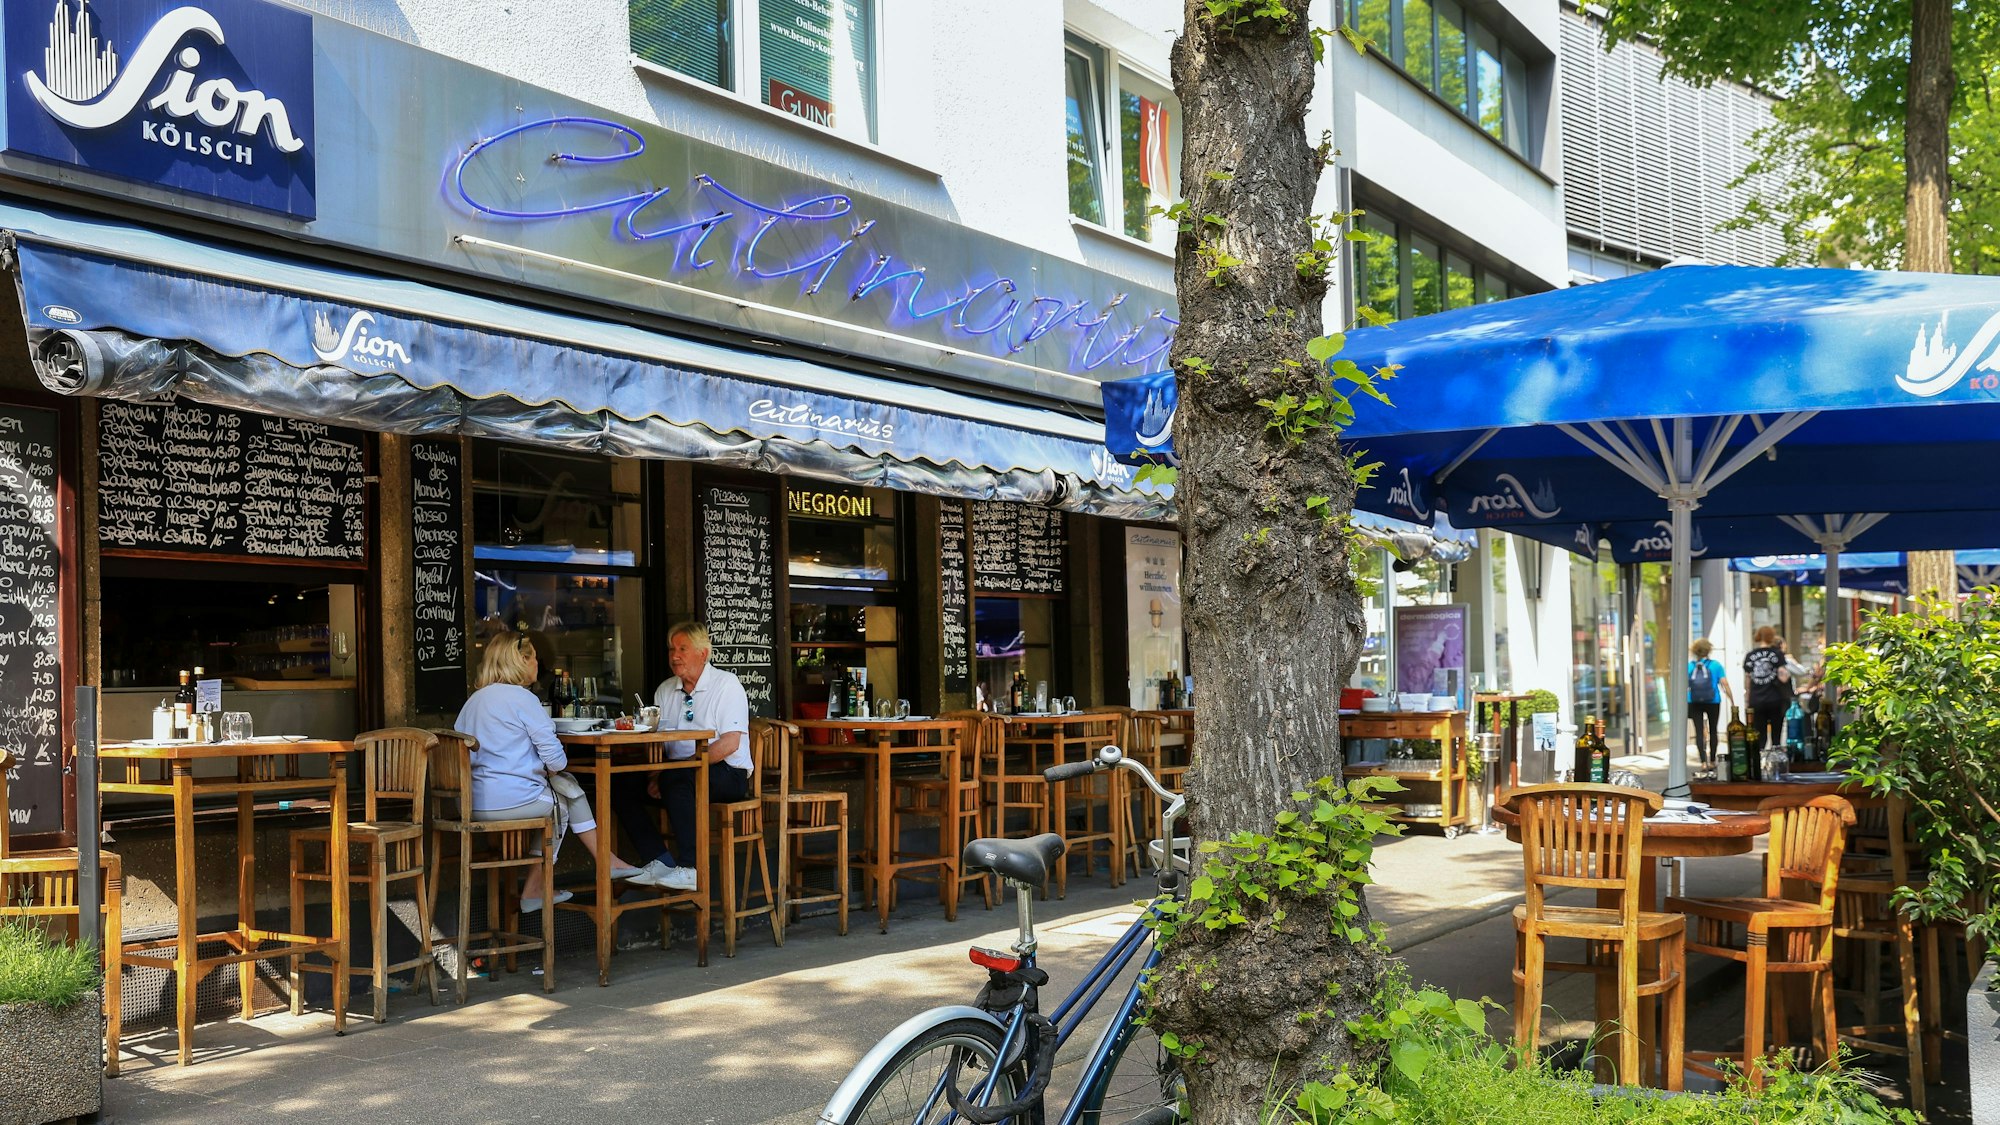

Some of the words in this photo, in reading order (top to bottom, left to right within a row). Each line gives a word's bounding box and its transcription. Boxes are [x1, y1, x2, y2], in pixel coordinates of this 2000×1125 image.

[24, 6, 304, 153] Sion
[142, 120, 252, 166] KÖLSCH
[311, 310, 411, 364] Sion
[352, 354, 395, 369] KÖLSCH
[749, 400, 893, 438] Culinarius
[412, 443, 457, 467] Rotwein
[429, 466, 449, 482] des
[414, 478, 451, 500] Monats
[412, 506, 448, 524] Rosso
[788, 490, 871, 517] NEGRONI
[414, 525, 458, 545] Veronese
[1400, 613, 1461, 621] dermalogica
